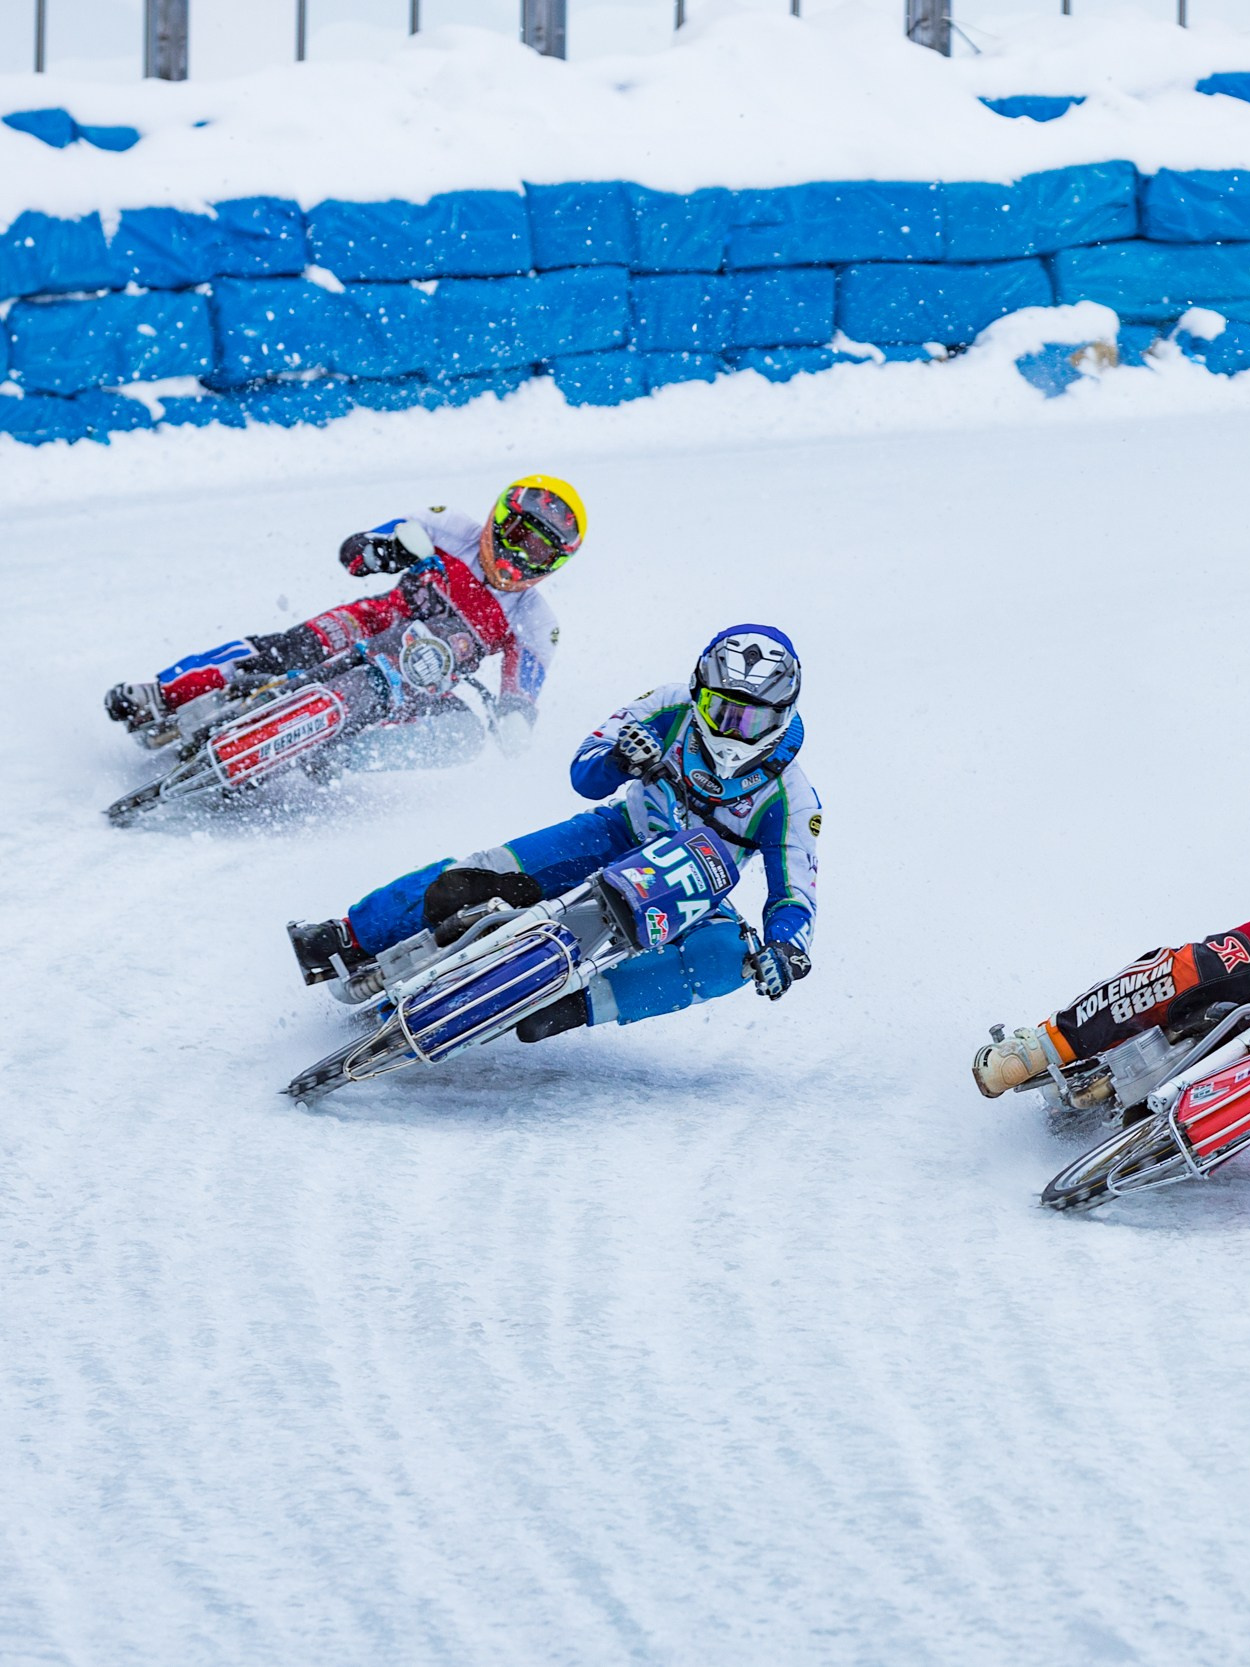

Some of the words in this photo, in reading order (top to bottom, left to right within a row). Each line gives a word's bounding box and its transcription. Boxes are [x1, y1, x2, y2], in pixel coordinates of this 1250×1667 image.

[641, 836, 711, 932] UFA
[1076, 957, 1173, 1028] KOLENKIN
[1109, 975, 1176, 1024] 888
